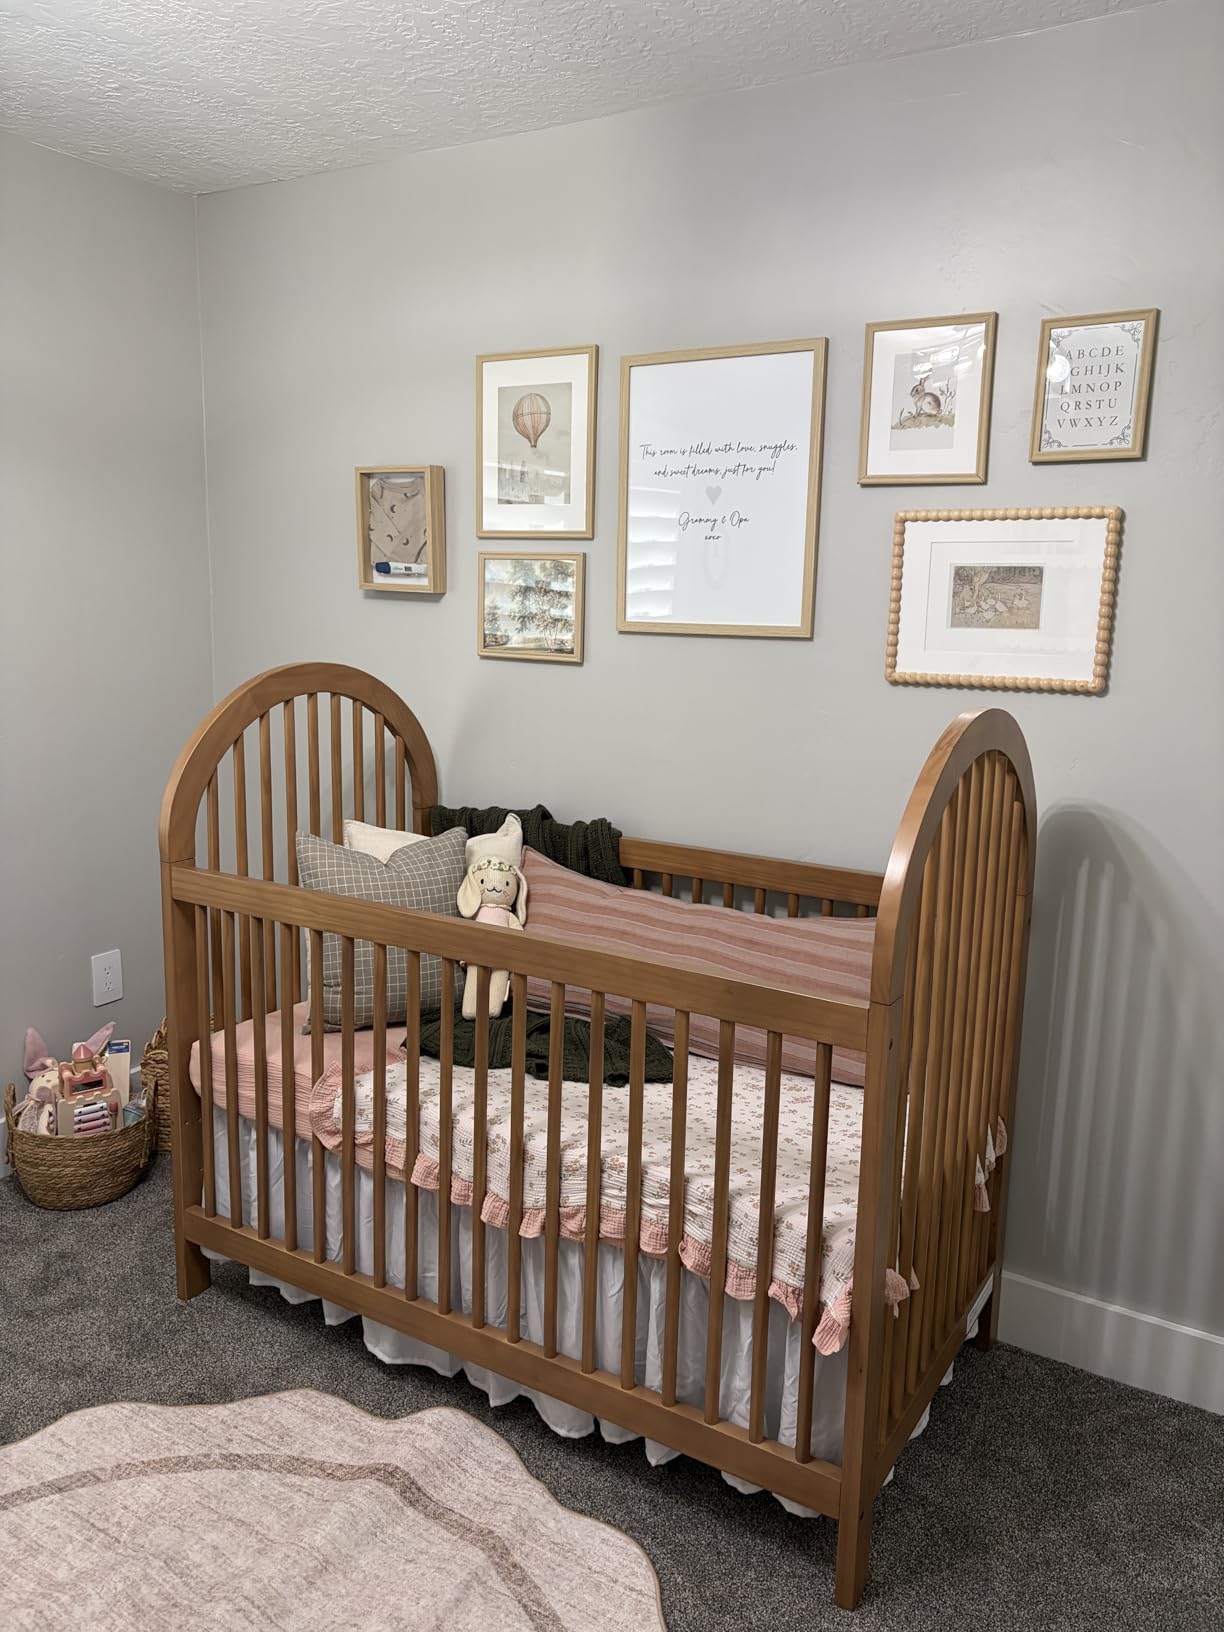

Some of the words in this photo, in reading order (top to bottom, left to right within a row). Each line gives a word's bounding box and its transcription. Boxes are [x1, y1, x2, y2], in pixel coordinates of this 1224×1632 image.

[1070, 362, 1125, 378] GHIJK
[640, 444, 657, 459] This
[680, 447, 687, 456] is
[688, 441, 713, 458] filled
[714, 441, 734, 454] with
[654, 464, 668, 477] and
[670, 464, 692, 477] sweet
[721, 461, 742, 480] just
[742, 464, 755, 476] for
[756, 460, 776, 480] you!
[678, 511, 718, 532] Grammy
[721, 515, 727, 525] &
[729, 511, 749, 528] Opa
